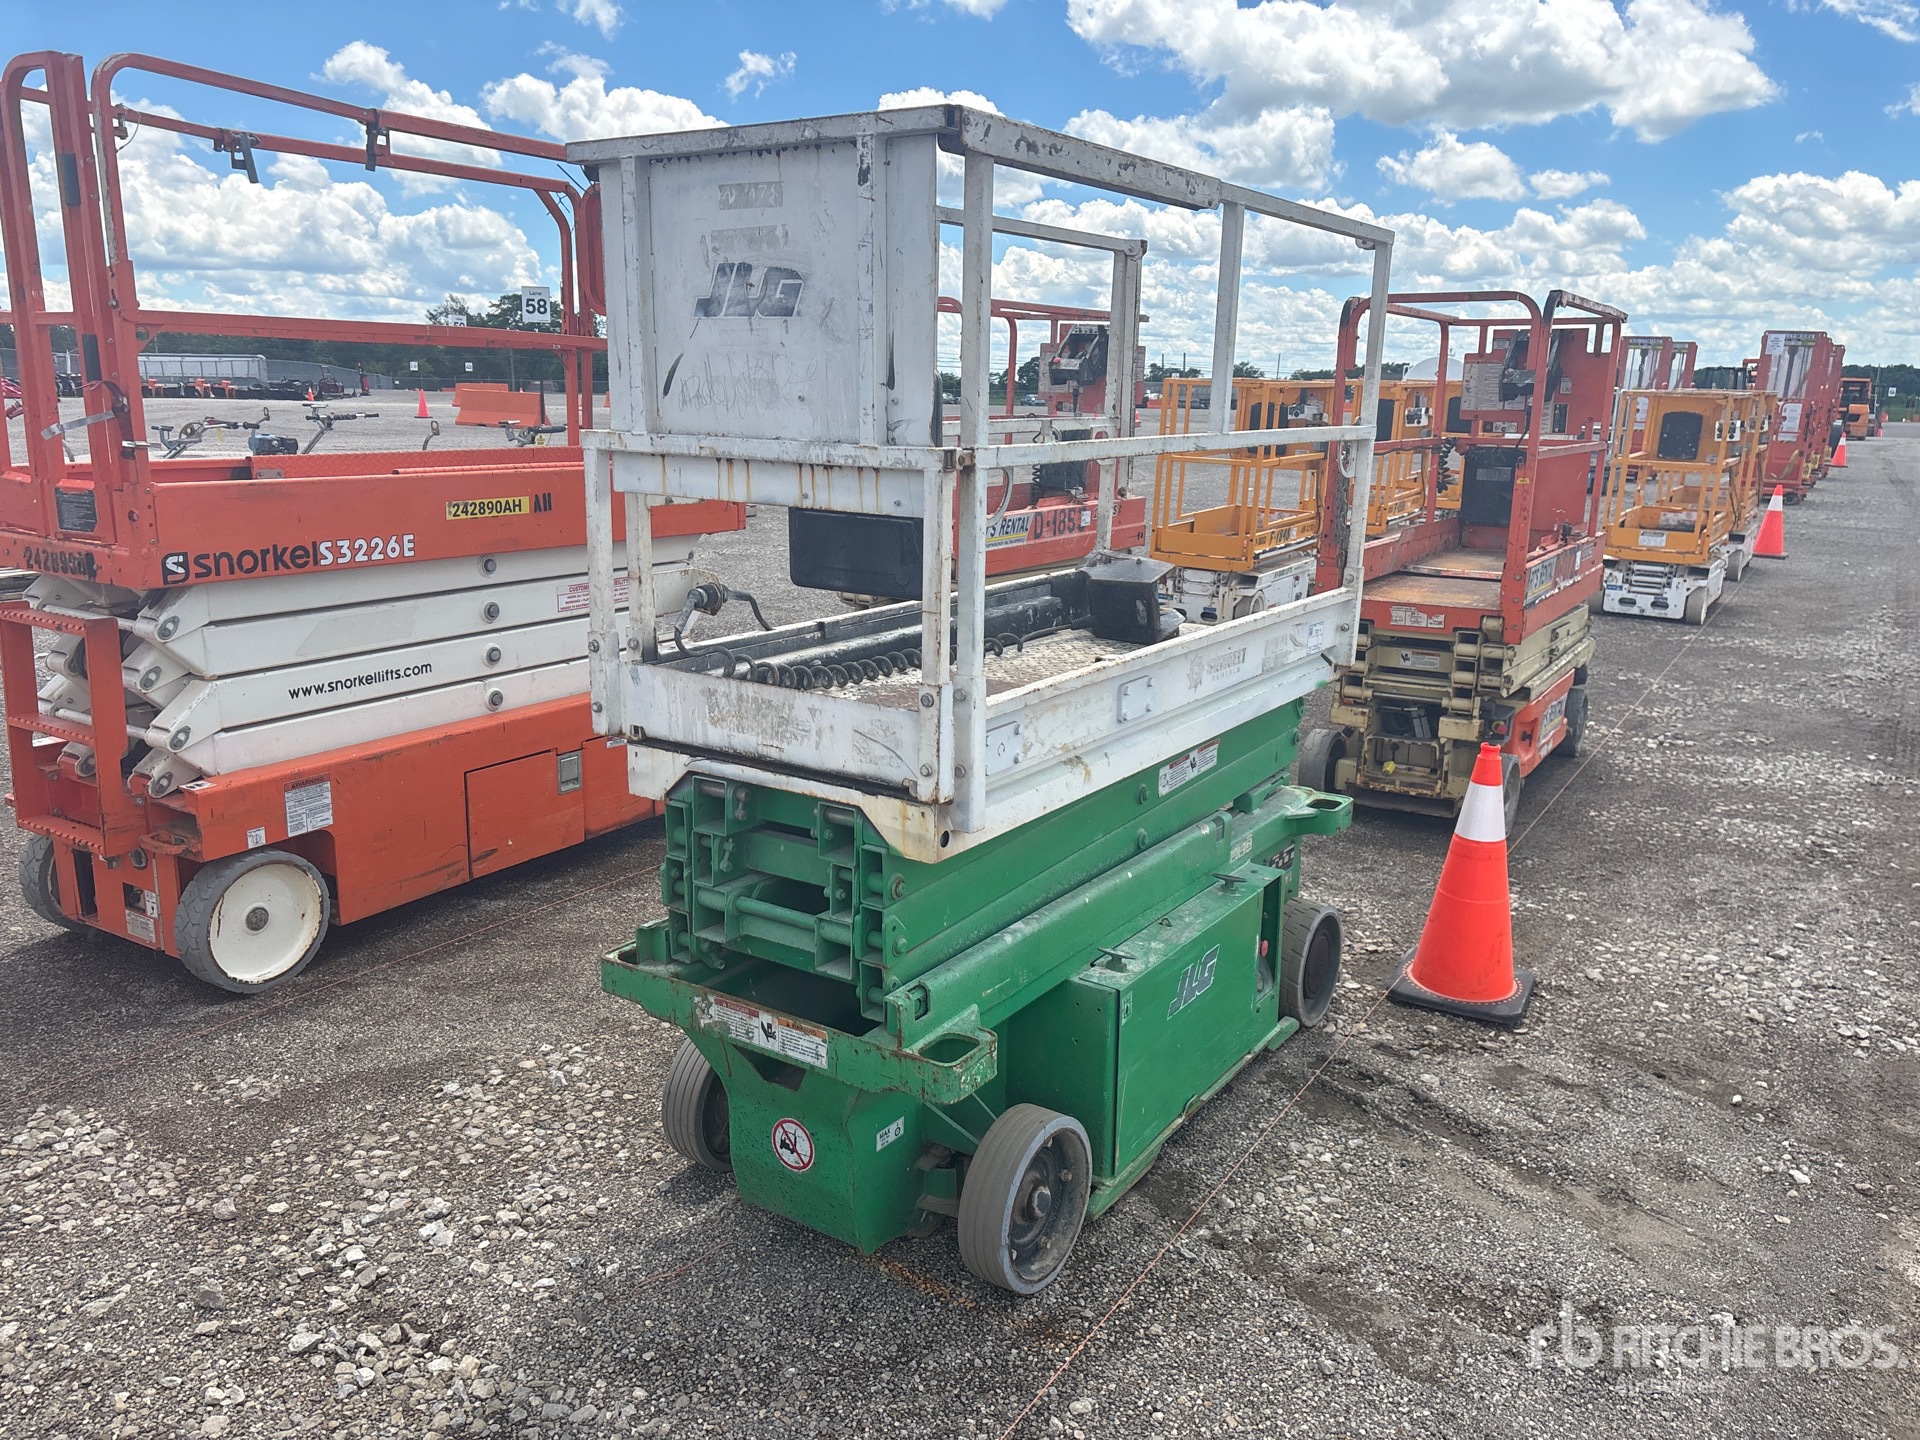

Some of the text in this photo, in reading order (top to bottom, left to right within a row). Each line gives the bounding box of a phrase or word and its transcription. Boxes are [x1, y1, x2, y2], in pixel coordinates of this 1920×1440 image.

[693, 262, 804, 318] JLG
[525, 298, 548, 315] 58
[451, 498, 522, 518] 242890AH
[1000, 515, 1029, 536] RENTAL
[193, 533, 415, 579] snorkel S3226E
[288, 662, 433, 700] www.snorkellifts.com
[295, 775, 325, 788] WARNING
[1167, 944, 1220, 1021] JLG
[727, 1001, 750, 1015] DANGER
[791, 1022, 817, 1037] WARNING
